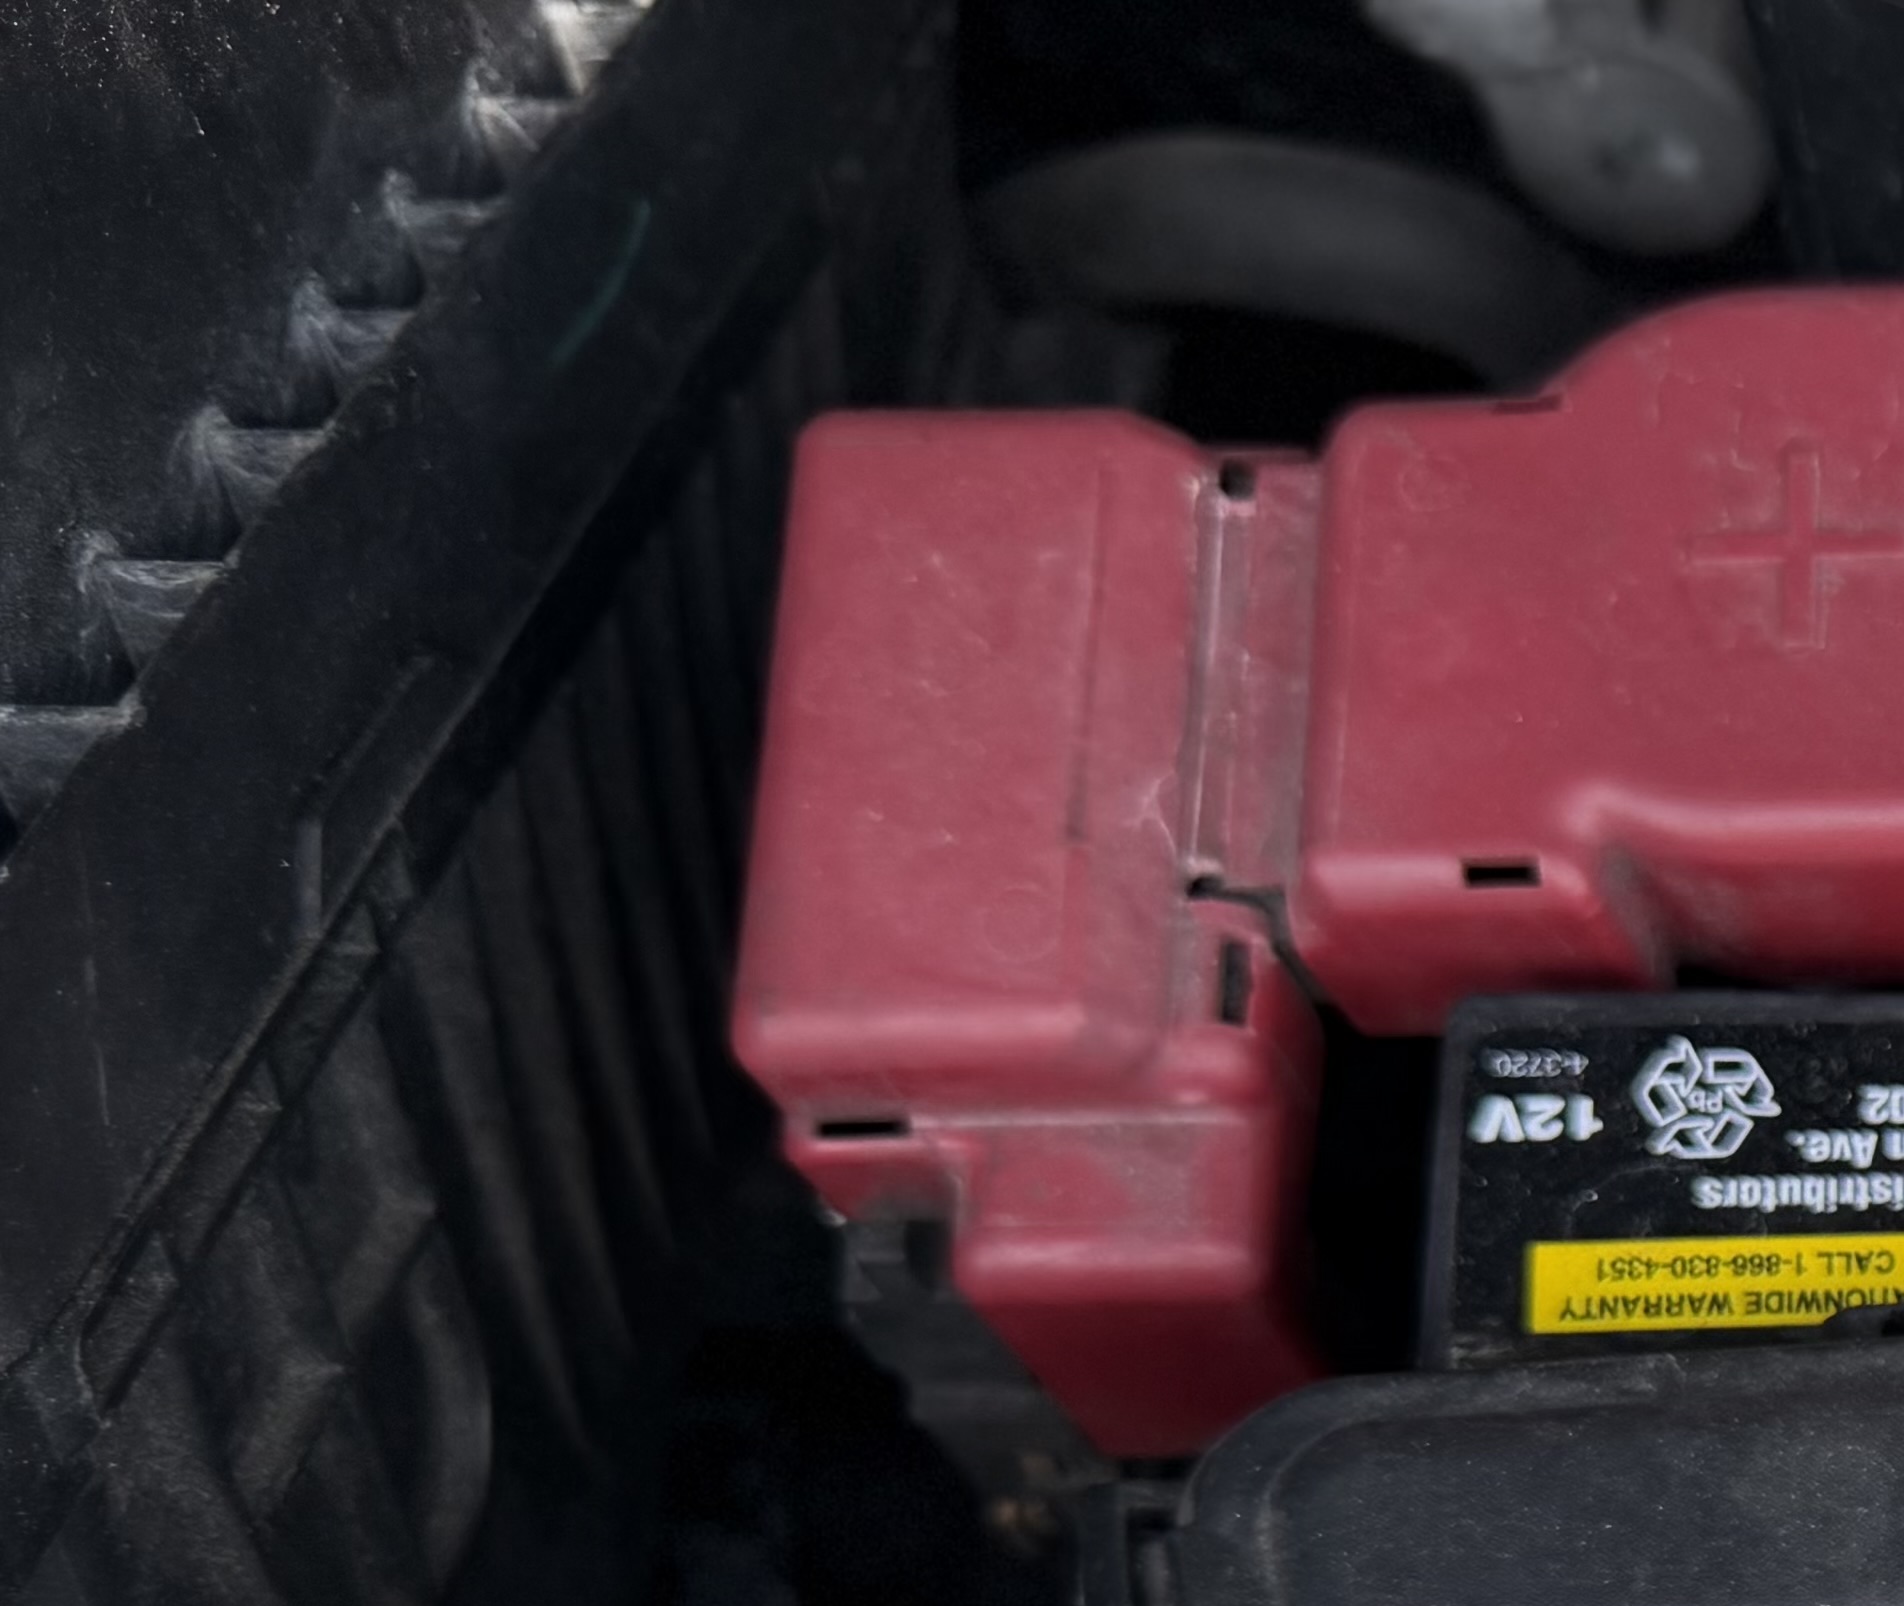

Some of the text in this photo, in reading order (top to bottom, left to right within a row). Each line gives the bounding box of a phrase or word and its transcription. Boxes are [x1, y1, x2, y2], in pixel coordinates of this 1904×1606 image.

[1686, 1088, 1723, 1114] Pb
[1465, 1093, 1604, 1143] 12V
[1786, 1128, 1878, 1168] Ave.
[1596, 1251, 1896, 1283] CALL 1-866-830-4351
[1559, 1293, 1733, 1322] WARRANTY
